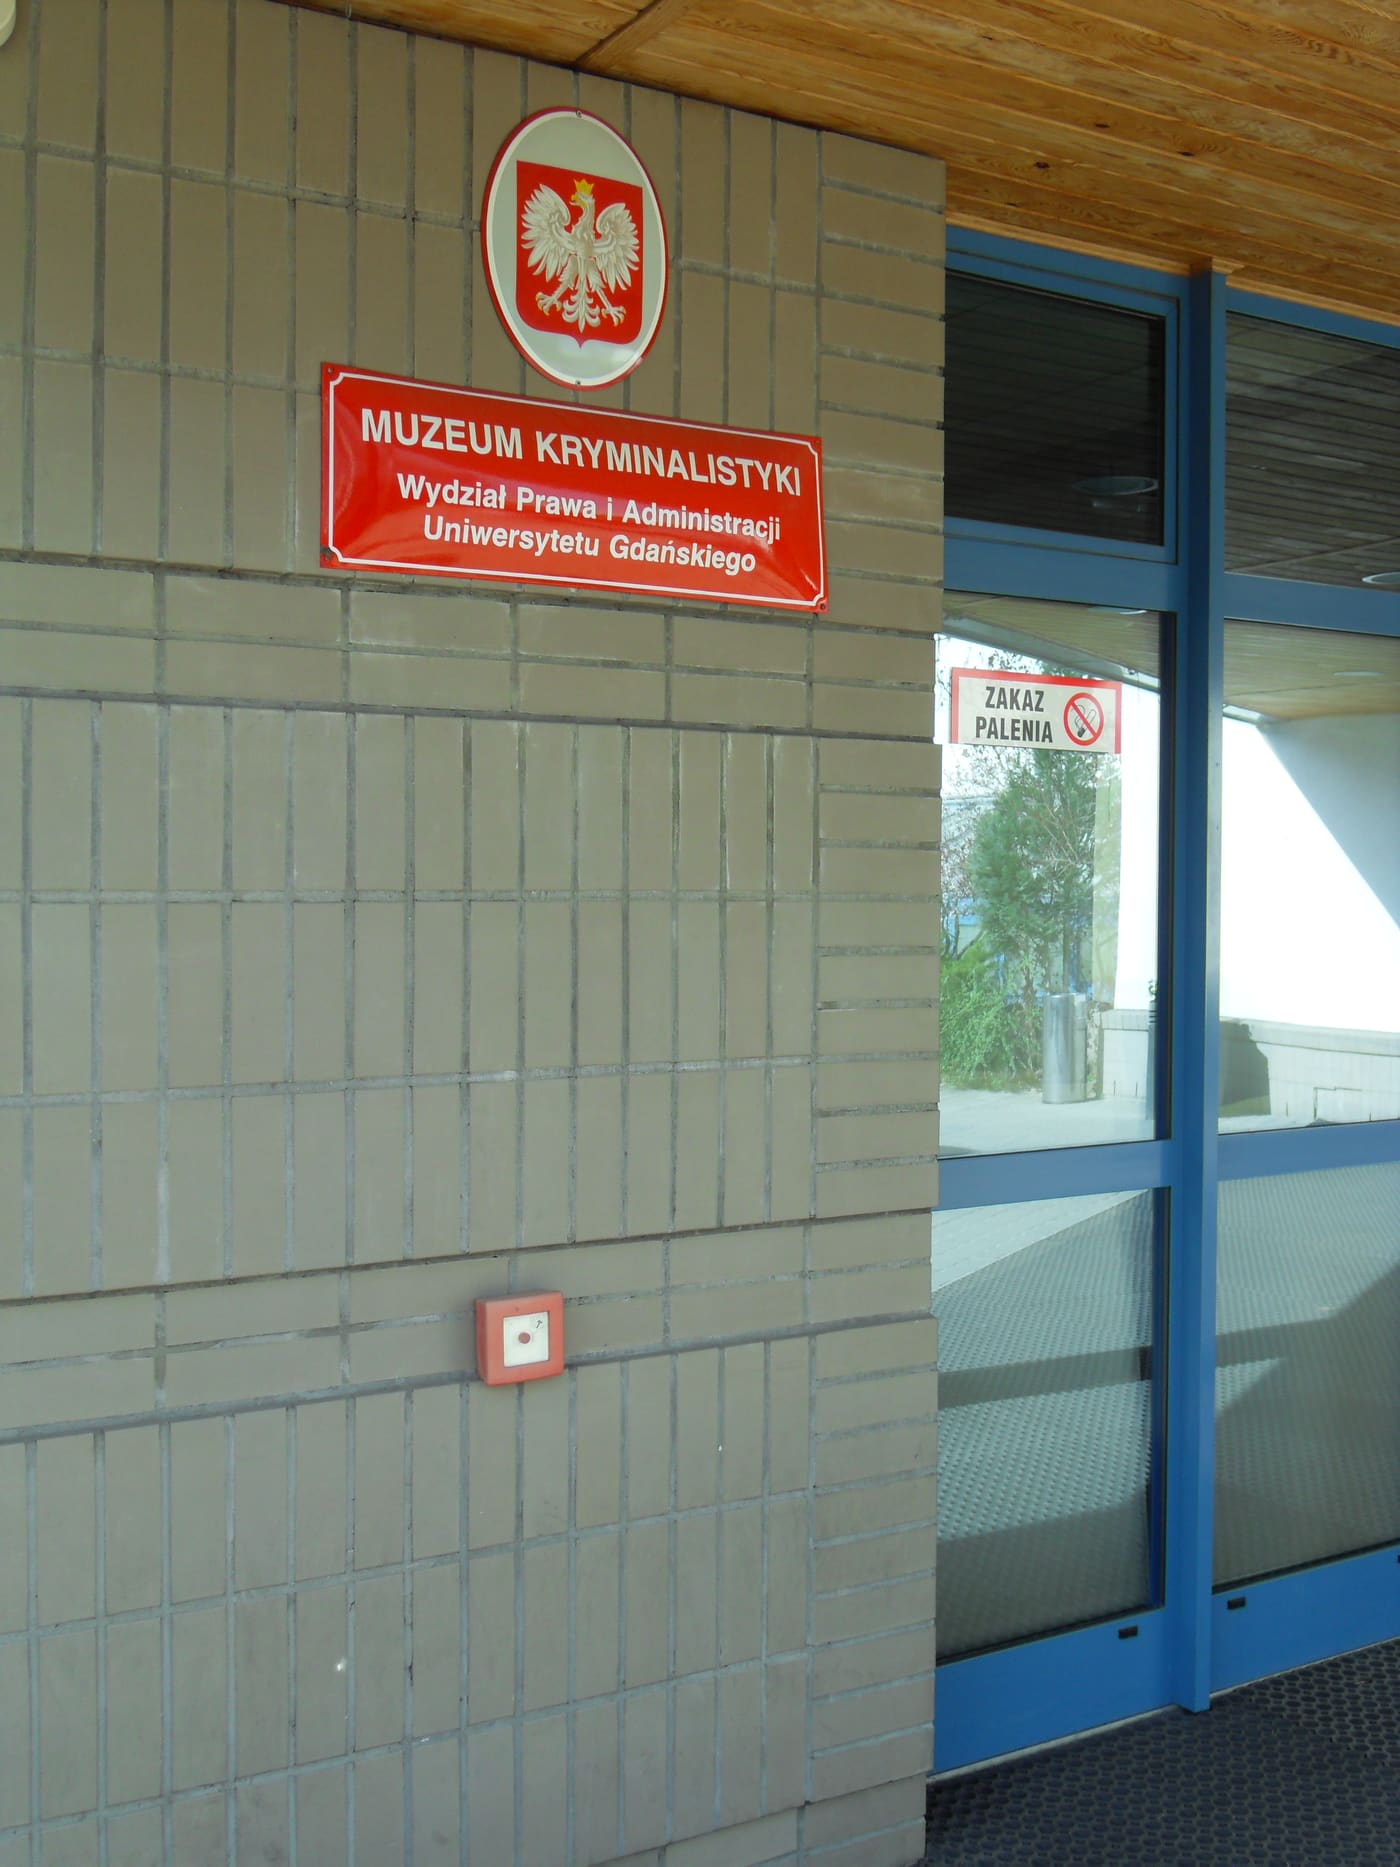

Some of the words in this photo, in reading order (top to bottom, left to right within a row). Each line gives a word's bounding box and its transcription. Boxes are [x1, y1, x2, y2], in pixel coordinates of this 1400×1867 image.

[361, 408, 523, 460] MUZEUM
[535, 432, 801, 497] KRYMINALISTYKI
[397, 473, 507, 510] Wydział
[517, 487, 597, 520] Prawa
[606, 497, 614, 519] i
[623, 500, 781, 545] Administracji
[424, 514, 600, 557] Uniwersytetu
[609, 535, 756, 578] Gdańskiego
[975, 716, 1053, 743] PALENIA
[985, 686, 1045, 713] ZAKAZ
